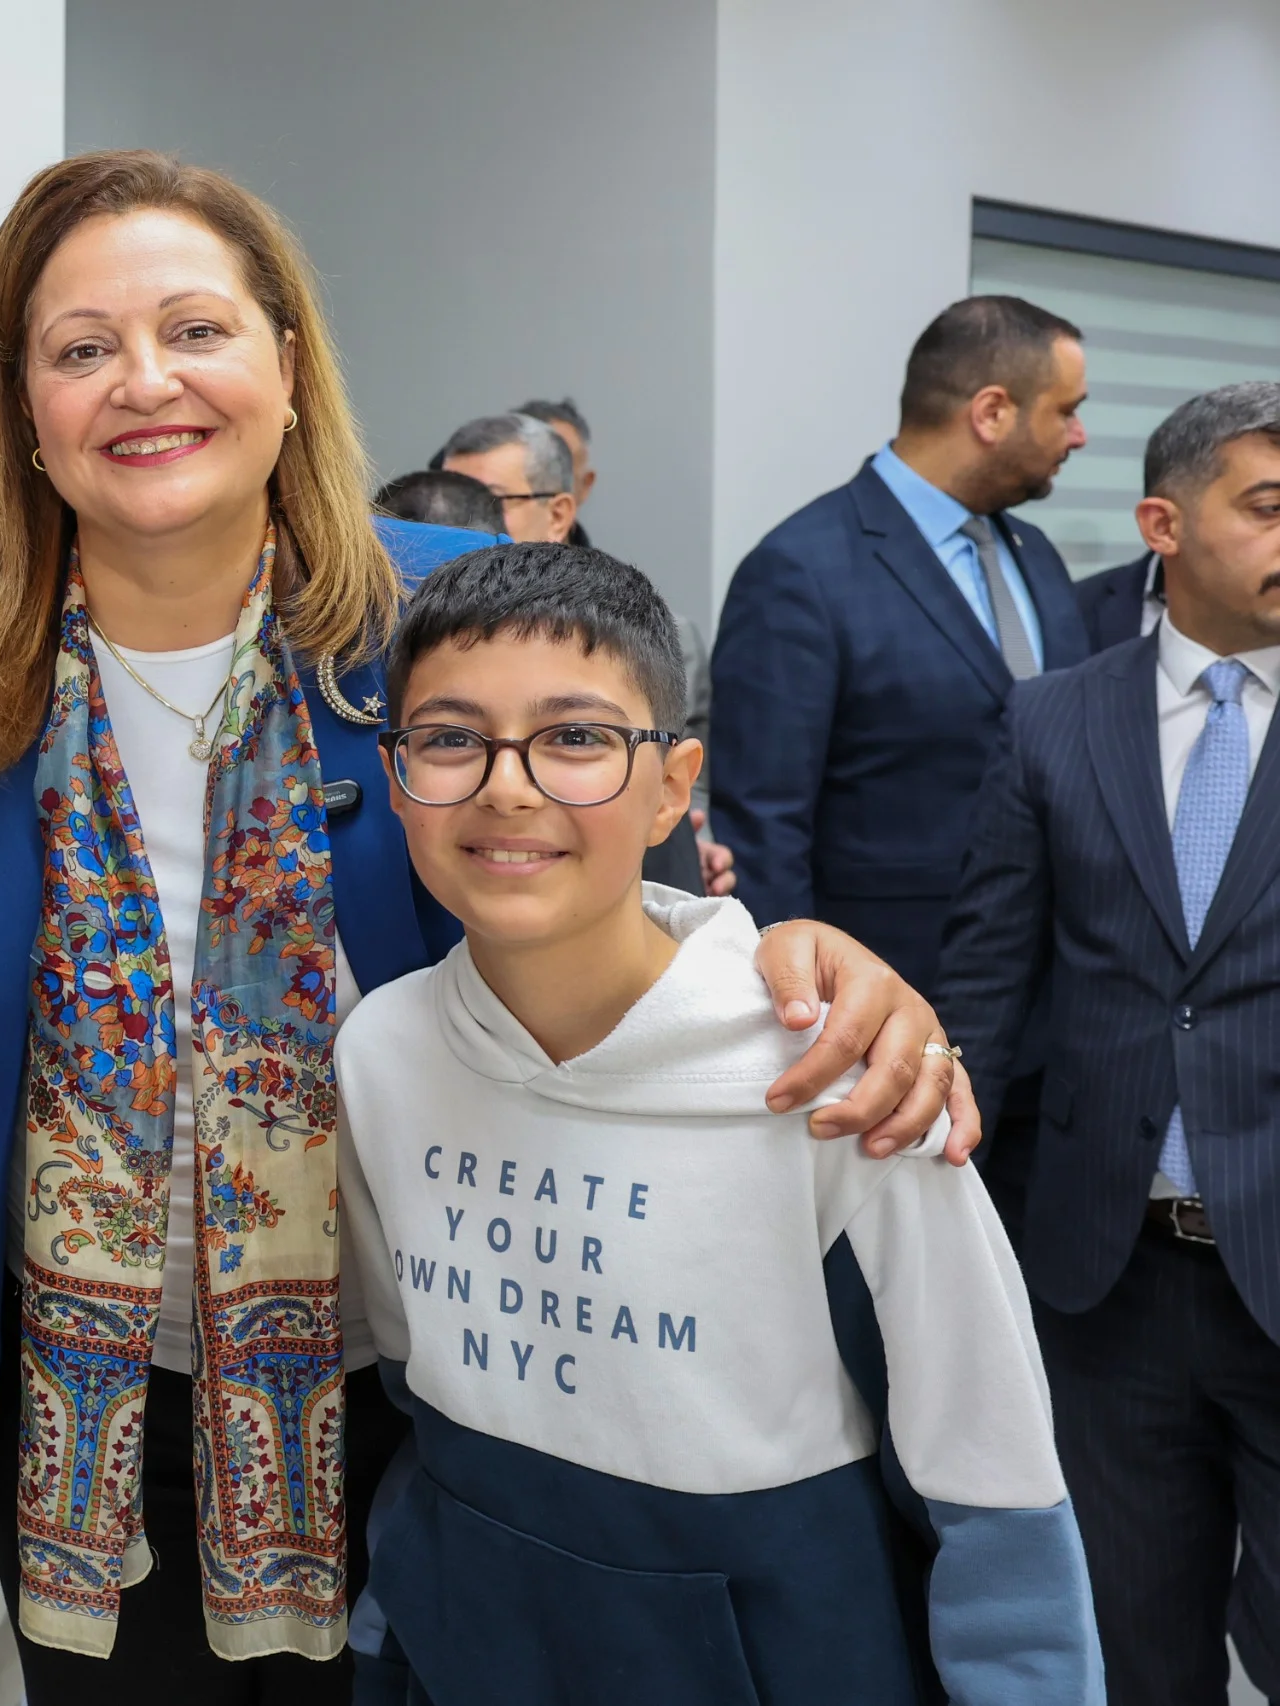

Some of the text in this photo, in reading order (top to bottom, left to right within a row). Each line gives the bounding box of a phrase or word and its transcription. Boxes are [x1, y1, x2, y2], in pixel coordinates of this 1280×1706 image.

[424, 1145, 649, 1220] CREATE
[445, 1205, 603, 1275] YOUR
[395, 1248, 696, 1353] OWN DREAM
[462, 1328, 576, 1395] NYC
